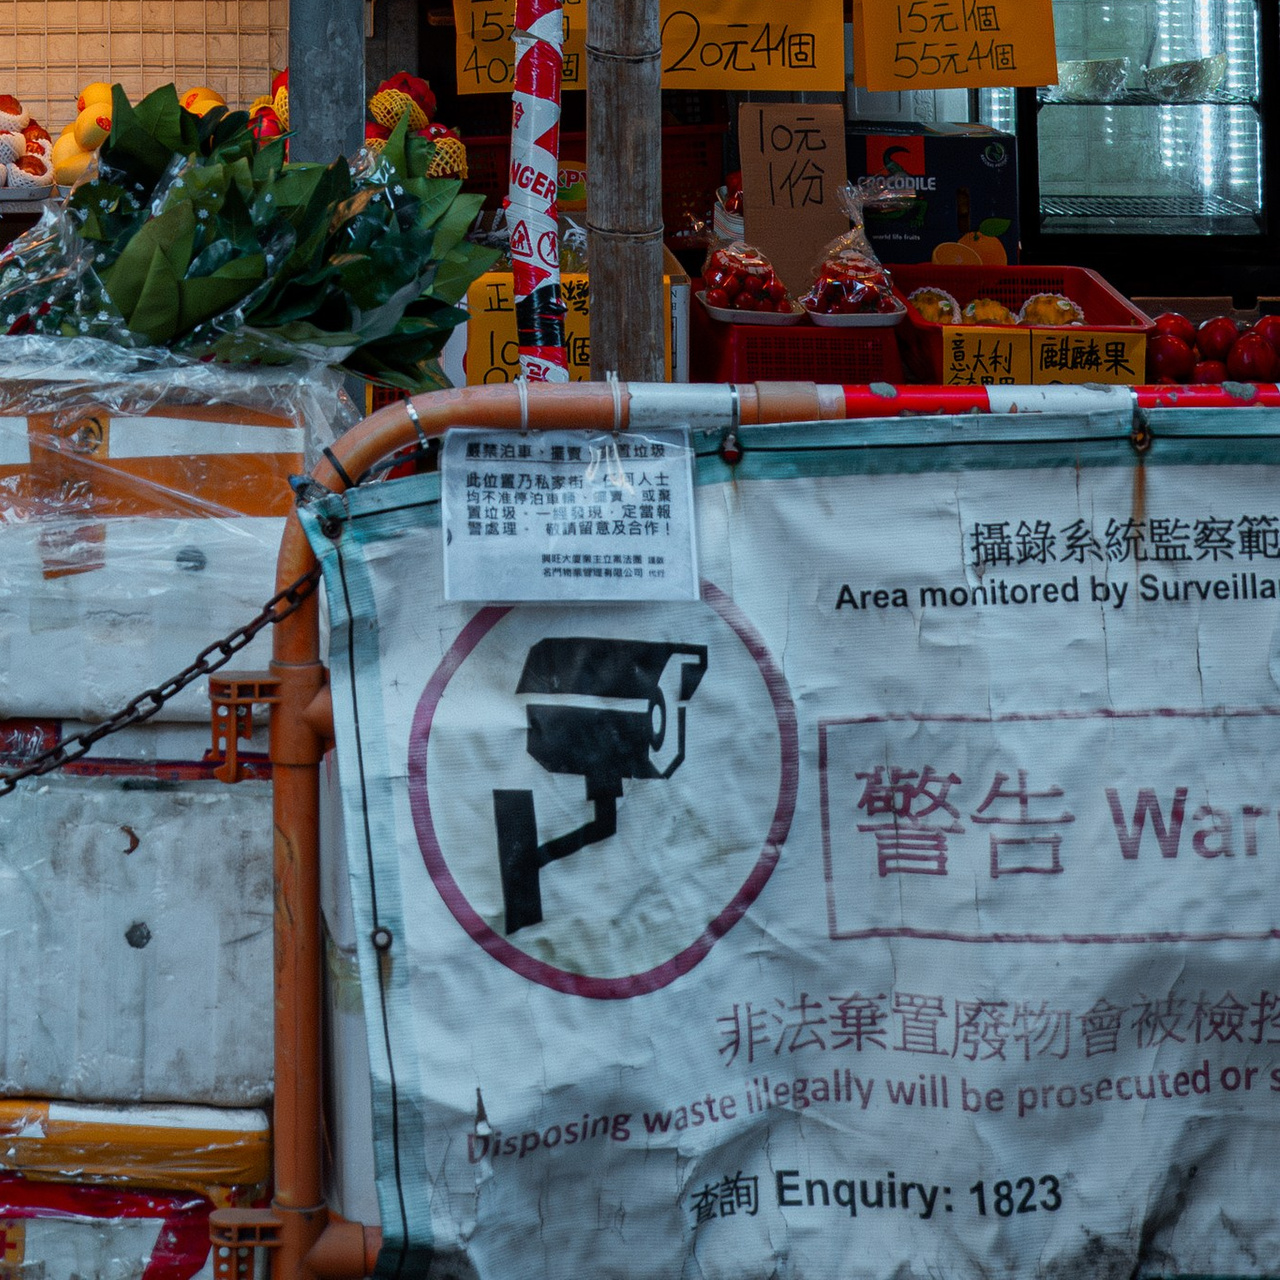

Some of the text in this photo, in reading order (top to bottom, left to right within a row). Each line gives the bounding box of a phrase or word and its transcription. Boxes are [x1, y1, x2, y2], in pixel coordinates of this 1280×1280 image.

[835, 583, 909, 611] Area
[920, 575, 1081, 608] monitored
[1091, 578, 1129, 609] by
[854, 764, 1076, 879] 警告
[466, 1108, 632, 1165] Disposing
[642, 1088, 738, 1136] waste
[745, 1066, 873, 1115] illegally
[885, 1062, 950, 1106] will
[961, 1074, 1006, 1113] be
[1017, 1059, 1211, 1119] prosecuted
[1221, 1066, 1259, 1092] or
[689, 1168, 1063, 1232] 查詢 Enquiry: 1823
